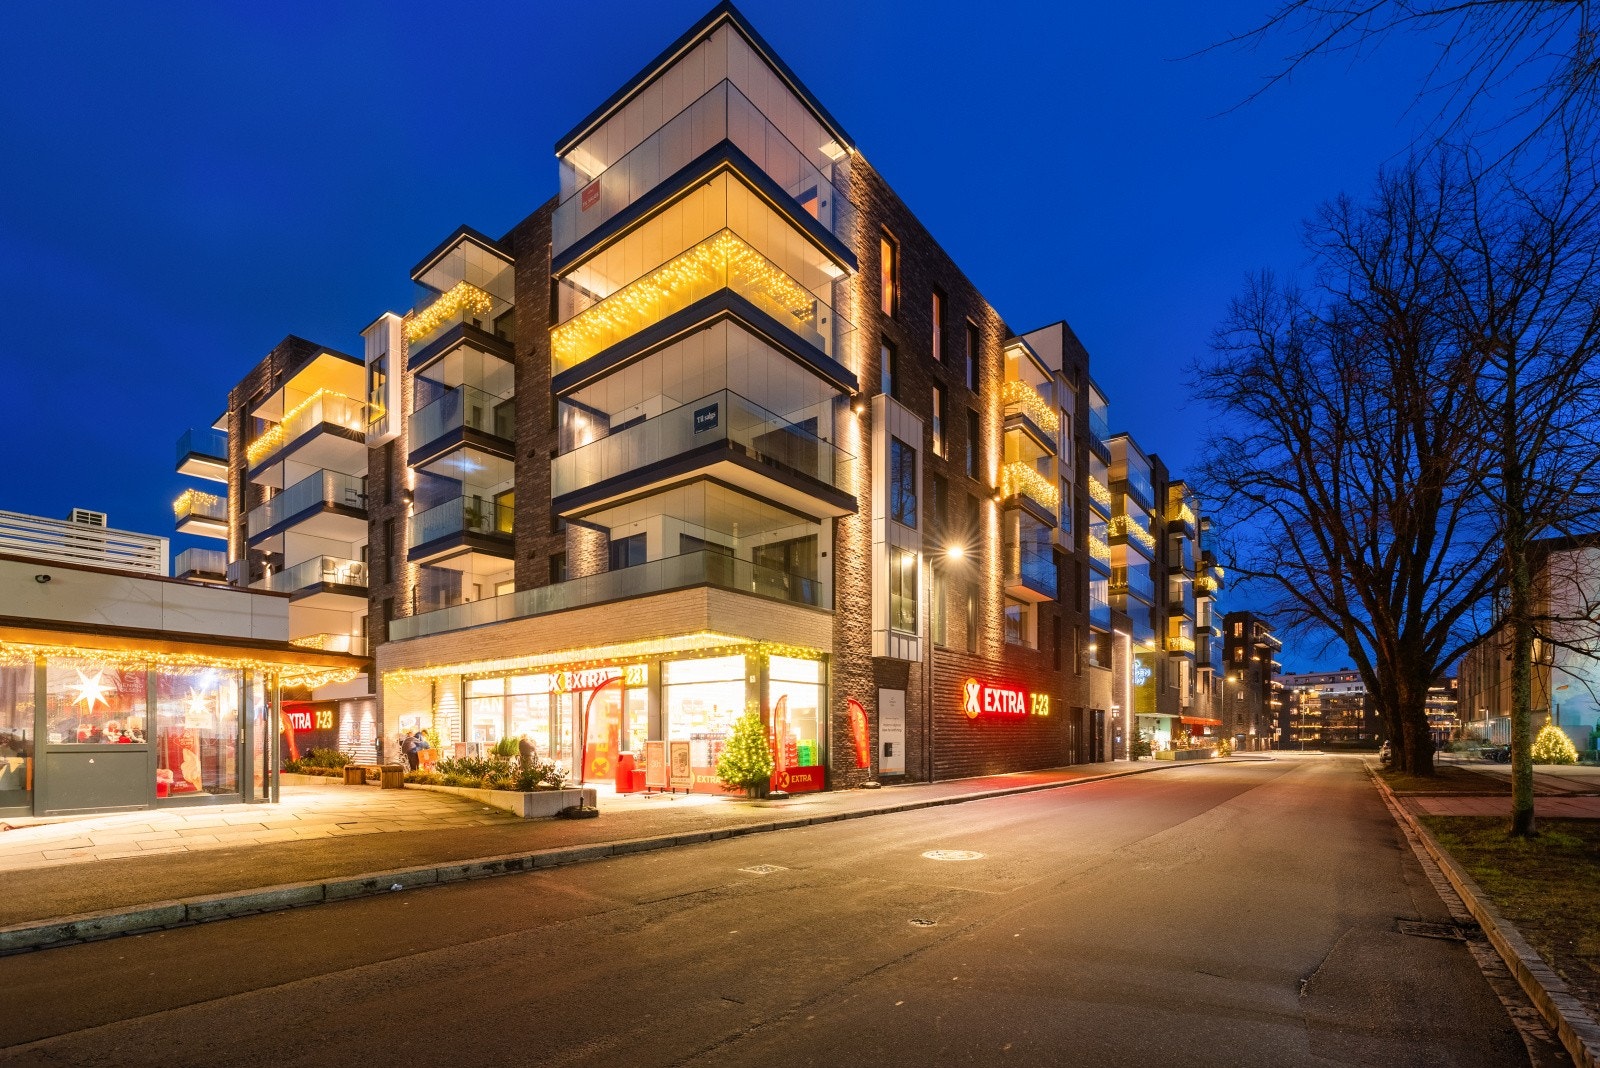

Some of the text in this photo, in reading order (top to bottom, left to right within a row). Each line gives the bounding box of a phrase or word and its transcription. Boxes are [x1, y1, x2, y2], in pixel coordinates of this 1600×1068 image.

[565, 671, 609, 690] EXTRA
[984, 687, 1026, 713] EXTRA
[1030, 693, 1049, 715] 7-23
[287, 711, 333, 729] XTRA 7-23
[697, 774, 721, 784] EXTRA
[791, 774, 812, 783] EXTRA
